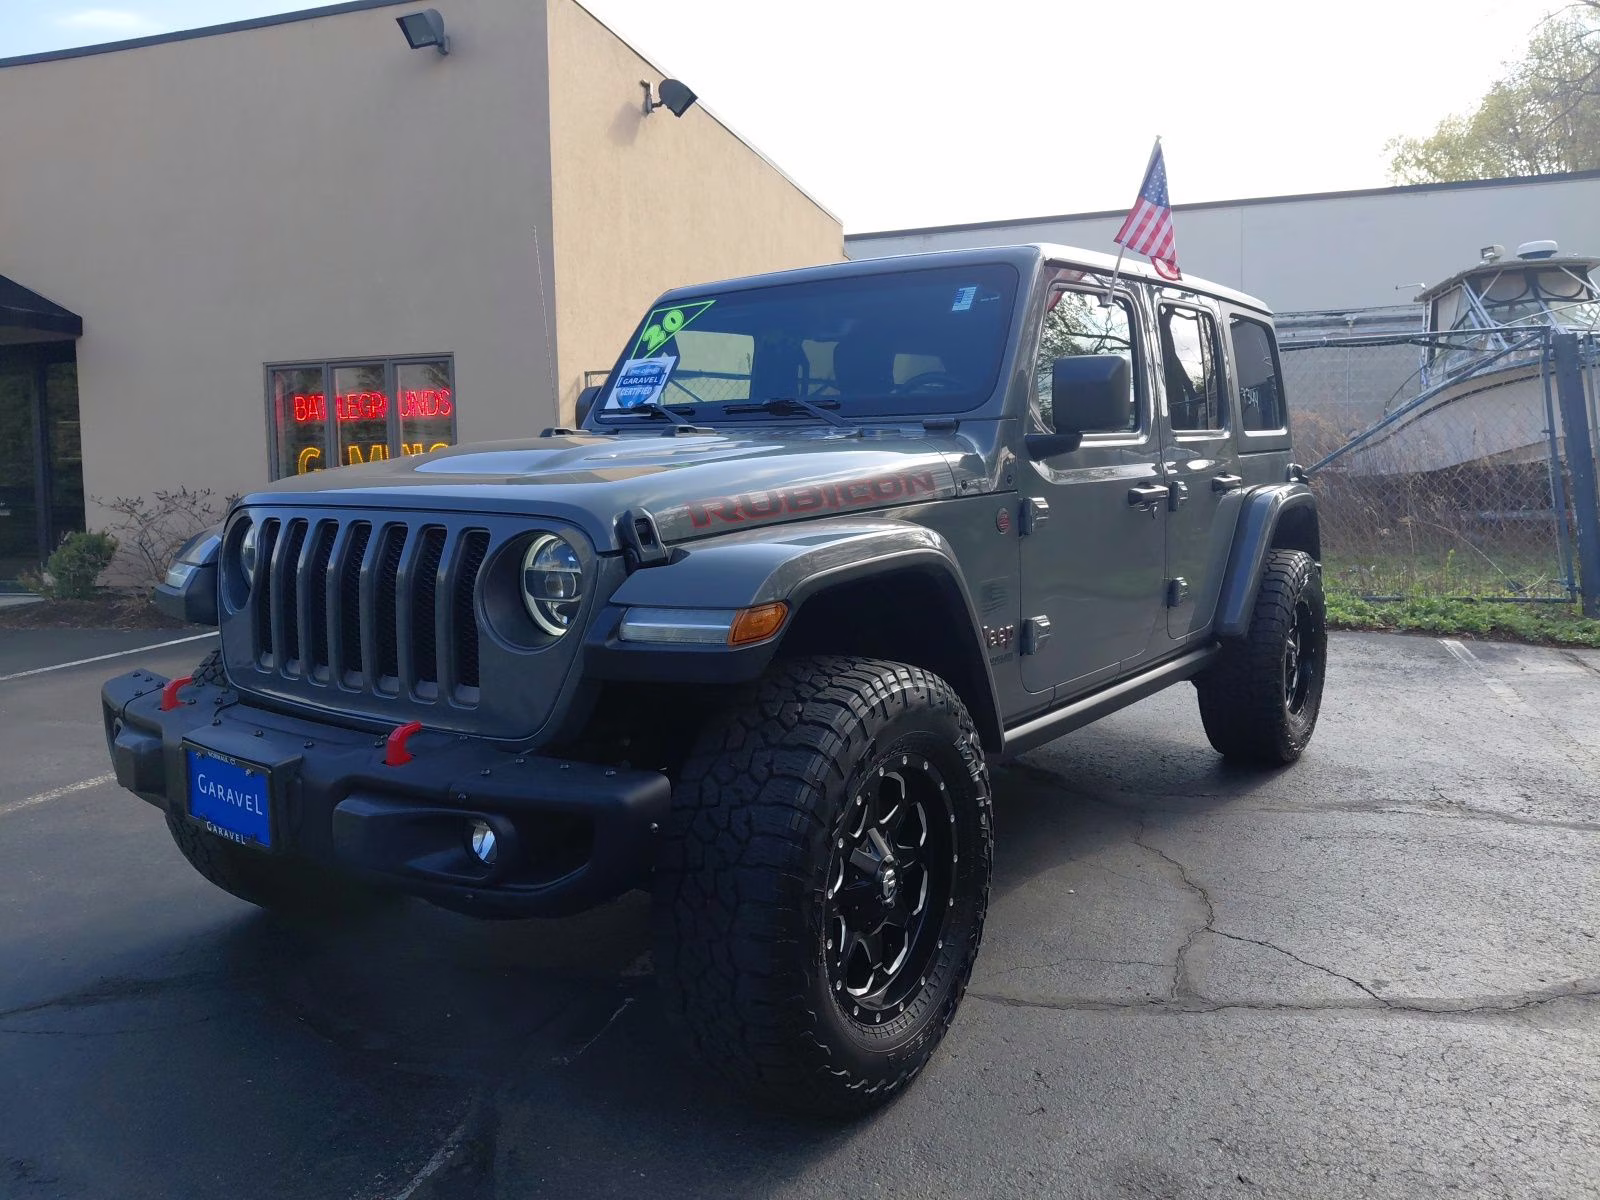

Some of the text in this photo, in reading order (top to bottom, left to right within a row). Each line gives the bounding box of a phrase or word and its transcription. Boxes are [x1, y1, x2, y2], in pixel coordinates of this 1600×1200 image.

[642, 309, 685, 351] 20
[294, 388, 453, 421] BATLEGRUNDS
[688, 471, 936, 529] RUBICON
[197, 773, 263, 816] GARAVEL
[206, 821, 246, 845] GARAVEL
